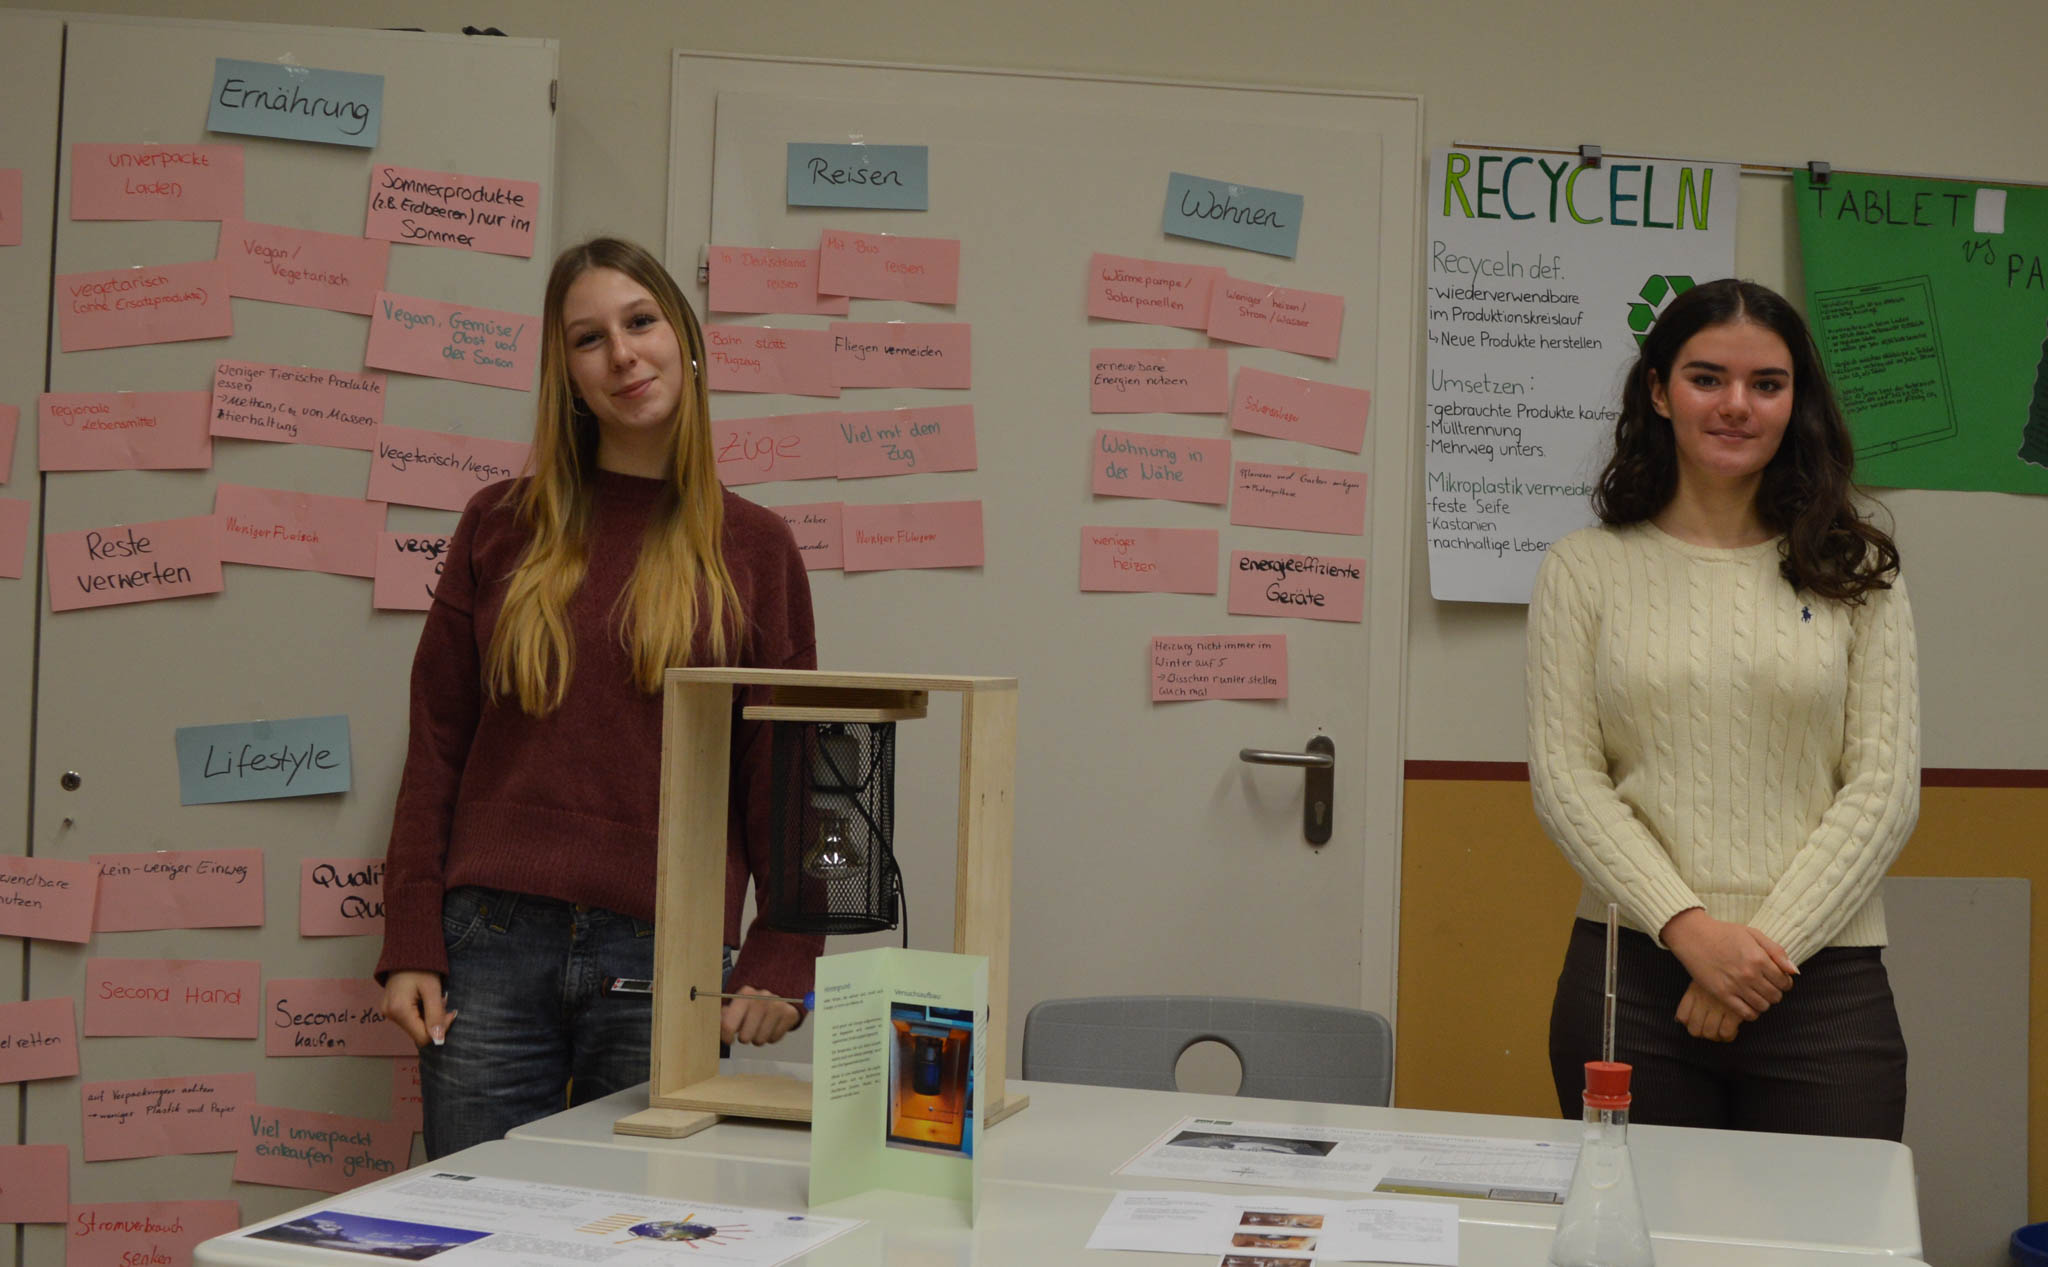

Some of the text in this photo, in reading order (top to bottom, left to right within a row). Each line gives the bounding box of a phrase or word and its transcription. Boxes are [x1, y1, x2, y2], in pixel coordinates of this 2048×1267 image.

[219, 79, 371, 135] Ernährung
[109, 152, 209, 168] unverpackt
[807, 157, 905, 187] Reisen
[125, 178, 183, 197] Laden
[381, 168, 526, 207] Sommerprodukte
[1442, 152, 1713, 231] RECYCELN
[1180, 189, 1287, 228] Wohnen
[1808, 187, 1969, 228] TABLET
[400, 219, 476, 247] Sommer
[477, 212, 505, 228] nur
[511, 216, 531, 232] im
[853, 240, 881, 254] Bus
[271, 263, 349, 285] Vegetarisch
[884, 260, 926, 275] reisen
[1432, 240, 1565, 285] Recyceln def.
[2006, 253, 2045, 290] PA
[1429, 306, 1584, 327] im Produktionskreislauf
[452, 331, 517, 352] Obst von
[707, 331, 744, 346] Bahn
[834, 336, 944, 360] Fliegen vermeiden
[1440, 331, 1602, 351] Neue Produkte herstellen
[442, 344, 514, 368] der Saison
[217, 380, 252, 392] essen
[218, 364, 265, 382] Weniger
[328, 373, 381, 394] Produkte
[1094, 373, 1188, 392] Energien nutzen
[302, 408, 324, 419] von
[1516, 403, 1576, 420] Produkte
[841, 420, 941, 444] Viel mit dem
[880, 442, 916, 467] Zug
[1101, 434, 1203, 464] Wohnung in
[1105, 463, 1184, 482] der Nähe
[1428, 471, 1593, 500] Mikroplastik vermeide
[1476, 498, 1510, 514] Seife
[86, 528, 154, 561] Reste
[1091, 536, 1136, 555] weniger
[1112, 555, 1156, 572] heizen
[77, 561, 192, 593] verwerten
[1265, 583, 1325, 607] Geräte
[1155, 640, 1272, 656] Heizung nicht immer im
[1155, 656, 1192, 668] Winter
[1194, 658, 1217, 668] auf
[203, 743, 341, 786] Lifestyle
[100, 981, 243, 1006] Second Hand
[16, 1033, 61, 1048] retten
[295, 1031, 347, 1049] kaufen
[251, 1115, 373, 1150] Viel unverpackt
[344, 1152, 396, 1176] gehen
[122, 1246, 173, 1267] senken
